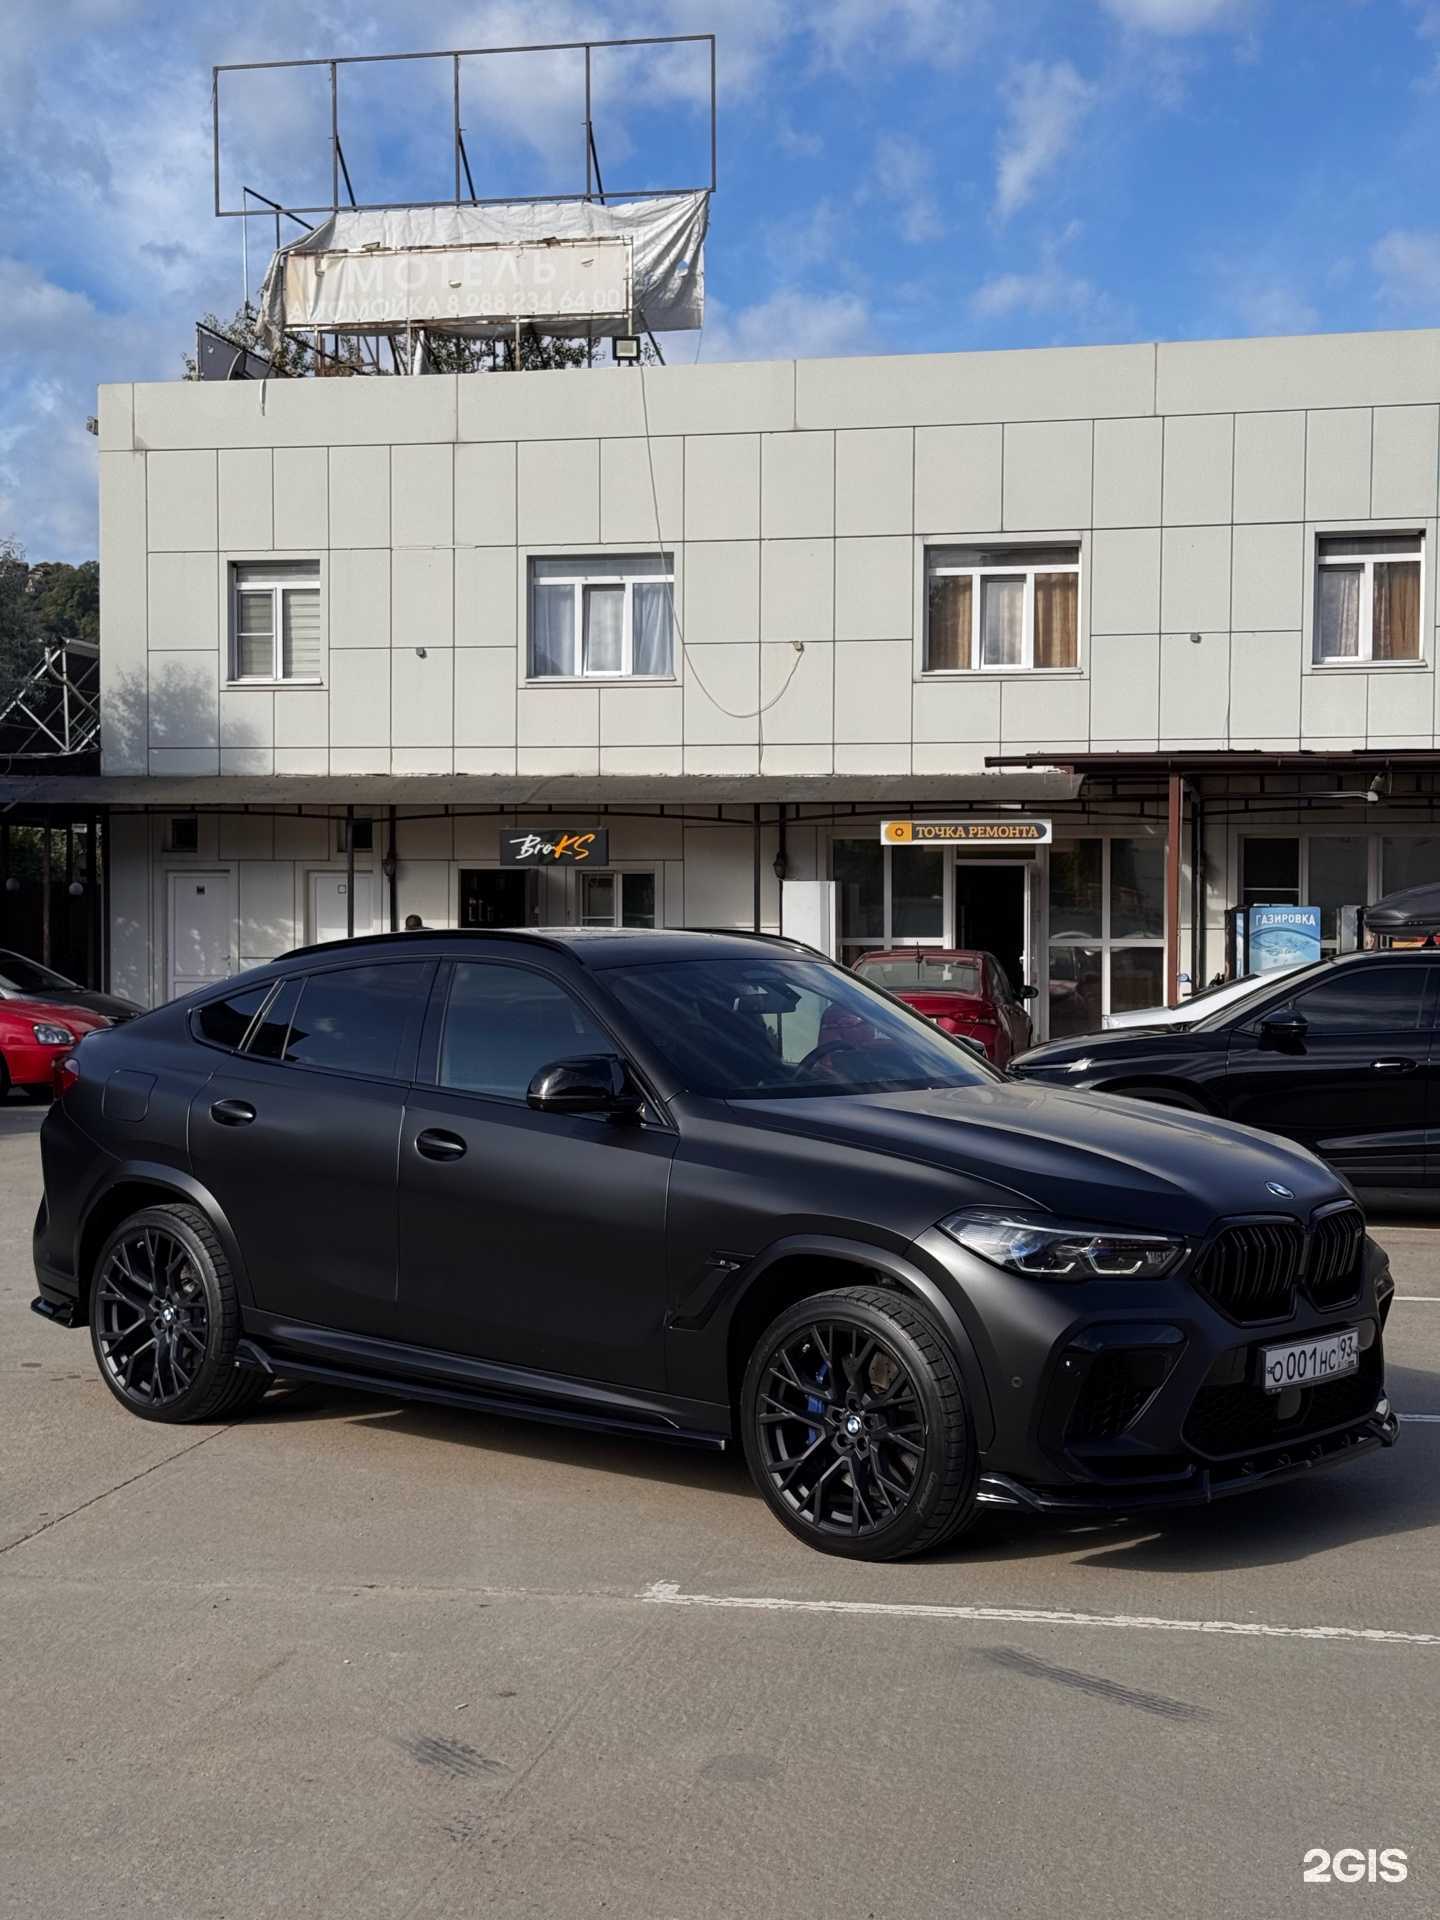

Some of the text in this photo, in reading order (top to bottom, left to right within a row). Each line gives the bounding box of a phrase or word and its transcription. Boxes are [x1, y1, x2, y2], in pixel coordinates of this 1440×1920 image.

[350, 252, 557, 292] МОТЕЛЬ
[447, 294, 459, 313] 8
[916, 826, 1040, 838] ТОЧКА РЕМОНТА
[509, 833, 596, 860] BroKS
[1255, 913, 1316, 926] ГАЗИРОВКА
